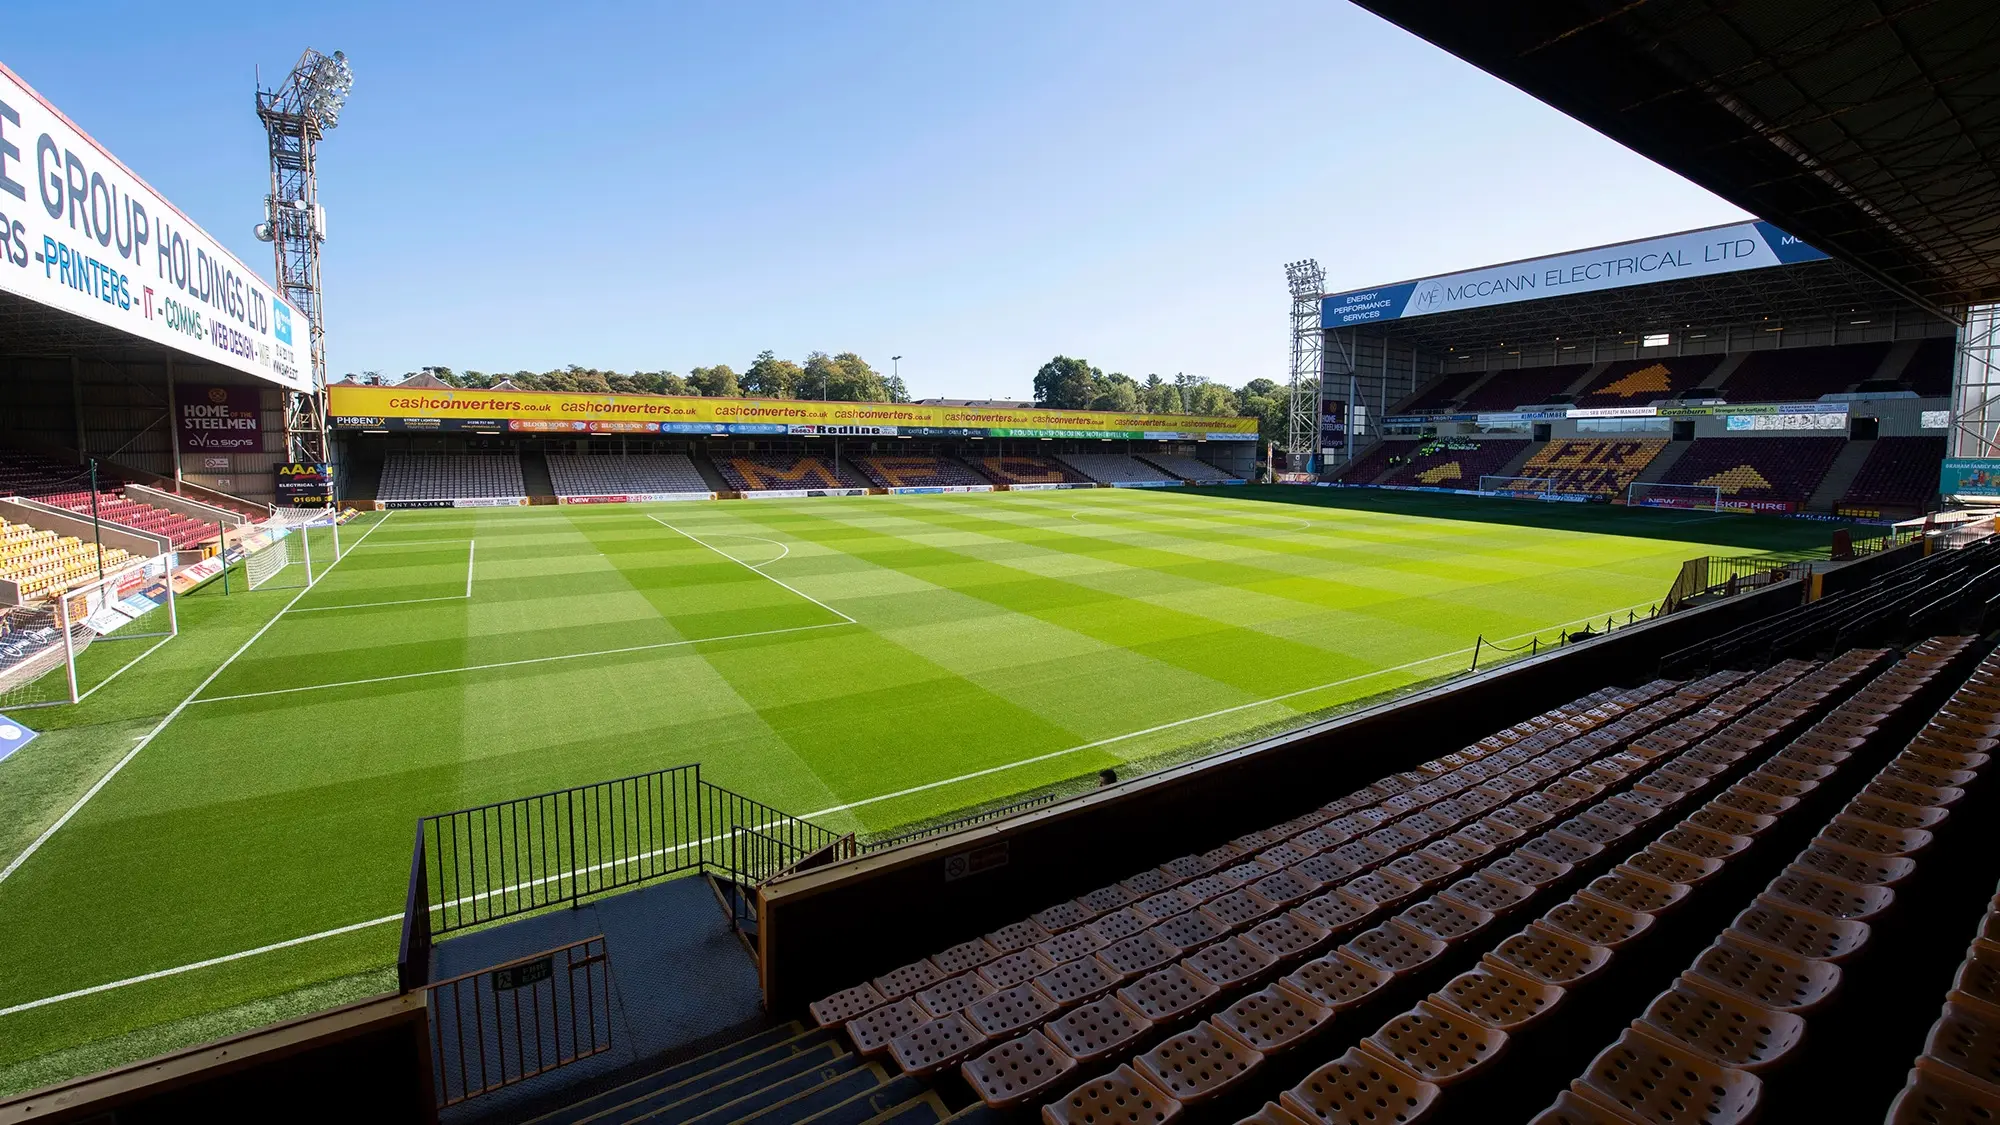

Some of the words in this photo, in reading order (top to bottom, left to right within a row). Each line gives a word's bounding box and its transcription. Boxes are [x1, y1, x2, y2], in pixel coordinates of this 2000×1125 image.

[37, 132, 149, 266] GROUP
[156, 216, 245, 324] HOLDINGS
[246, 283, 267, 335] LTD
[1447, 273, 1536, 302] MCCANN
[1545, 249, 1692, 287] ELECTRICAL
[1705, 238, 1755, 263] LTD
[1346, 292, 1378, 304] ENERGY
[1333, 300, 1391, 315] PERFORMANCE
[1343, 310, 1380, 322] SERVICES
[165, 296, 203, 341] COMMS
[209, 318, 229, 351] WEB
[228, 328, 255, 362] DESIGN
[184, 405, 229, 418] HOME
[389, 396, 551, 412] cashconverters.co.uk
[561, 401, 697, 415] cashconverters.co.uk
[715, 405, 828, 418] cashconverters.co.uk
[834, 409, 931, 421] cashconverters.co.uk
[945, 412, 1028, 423] cashconverters.co.uk
[185, 419, 256, 430] STEELMEN
[816, 426, 880, 434] Redline
[1548, 442, 1642, 464] FIR
[1715, 501, 1749, 509] SKIP
[1750, 502, 1783, 511] HIRE
[521, 962, 545, 975] FIRE
[521, 969, 548, 984] EXIT
